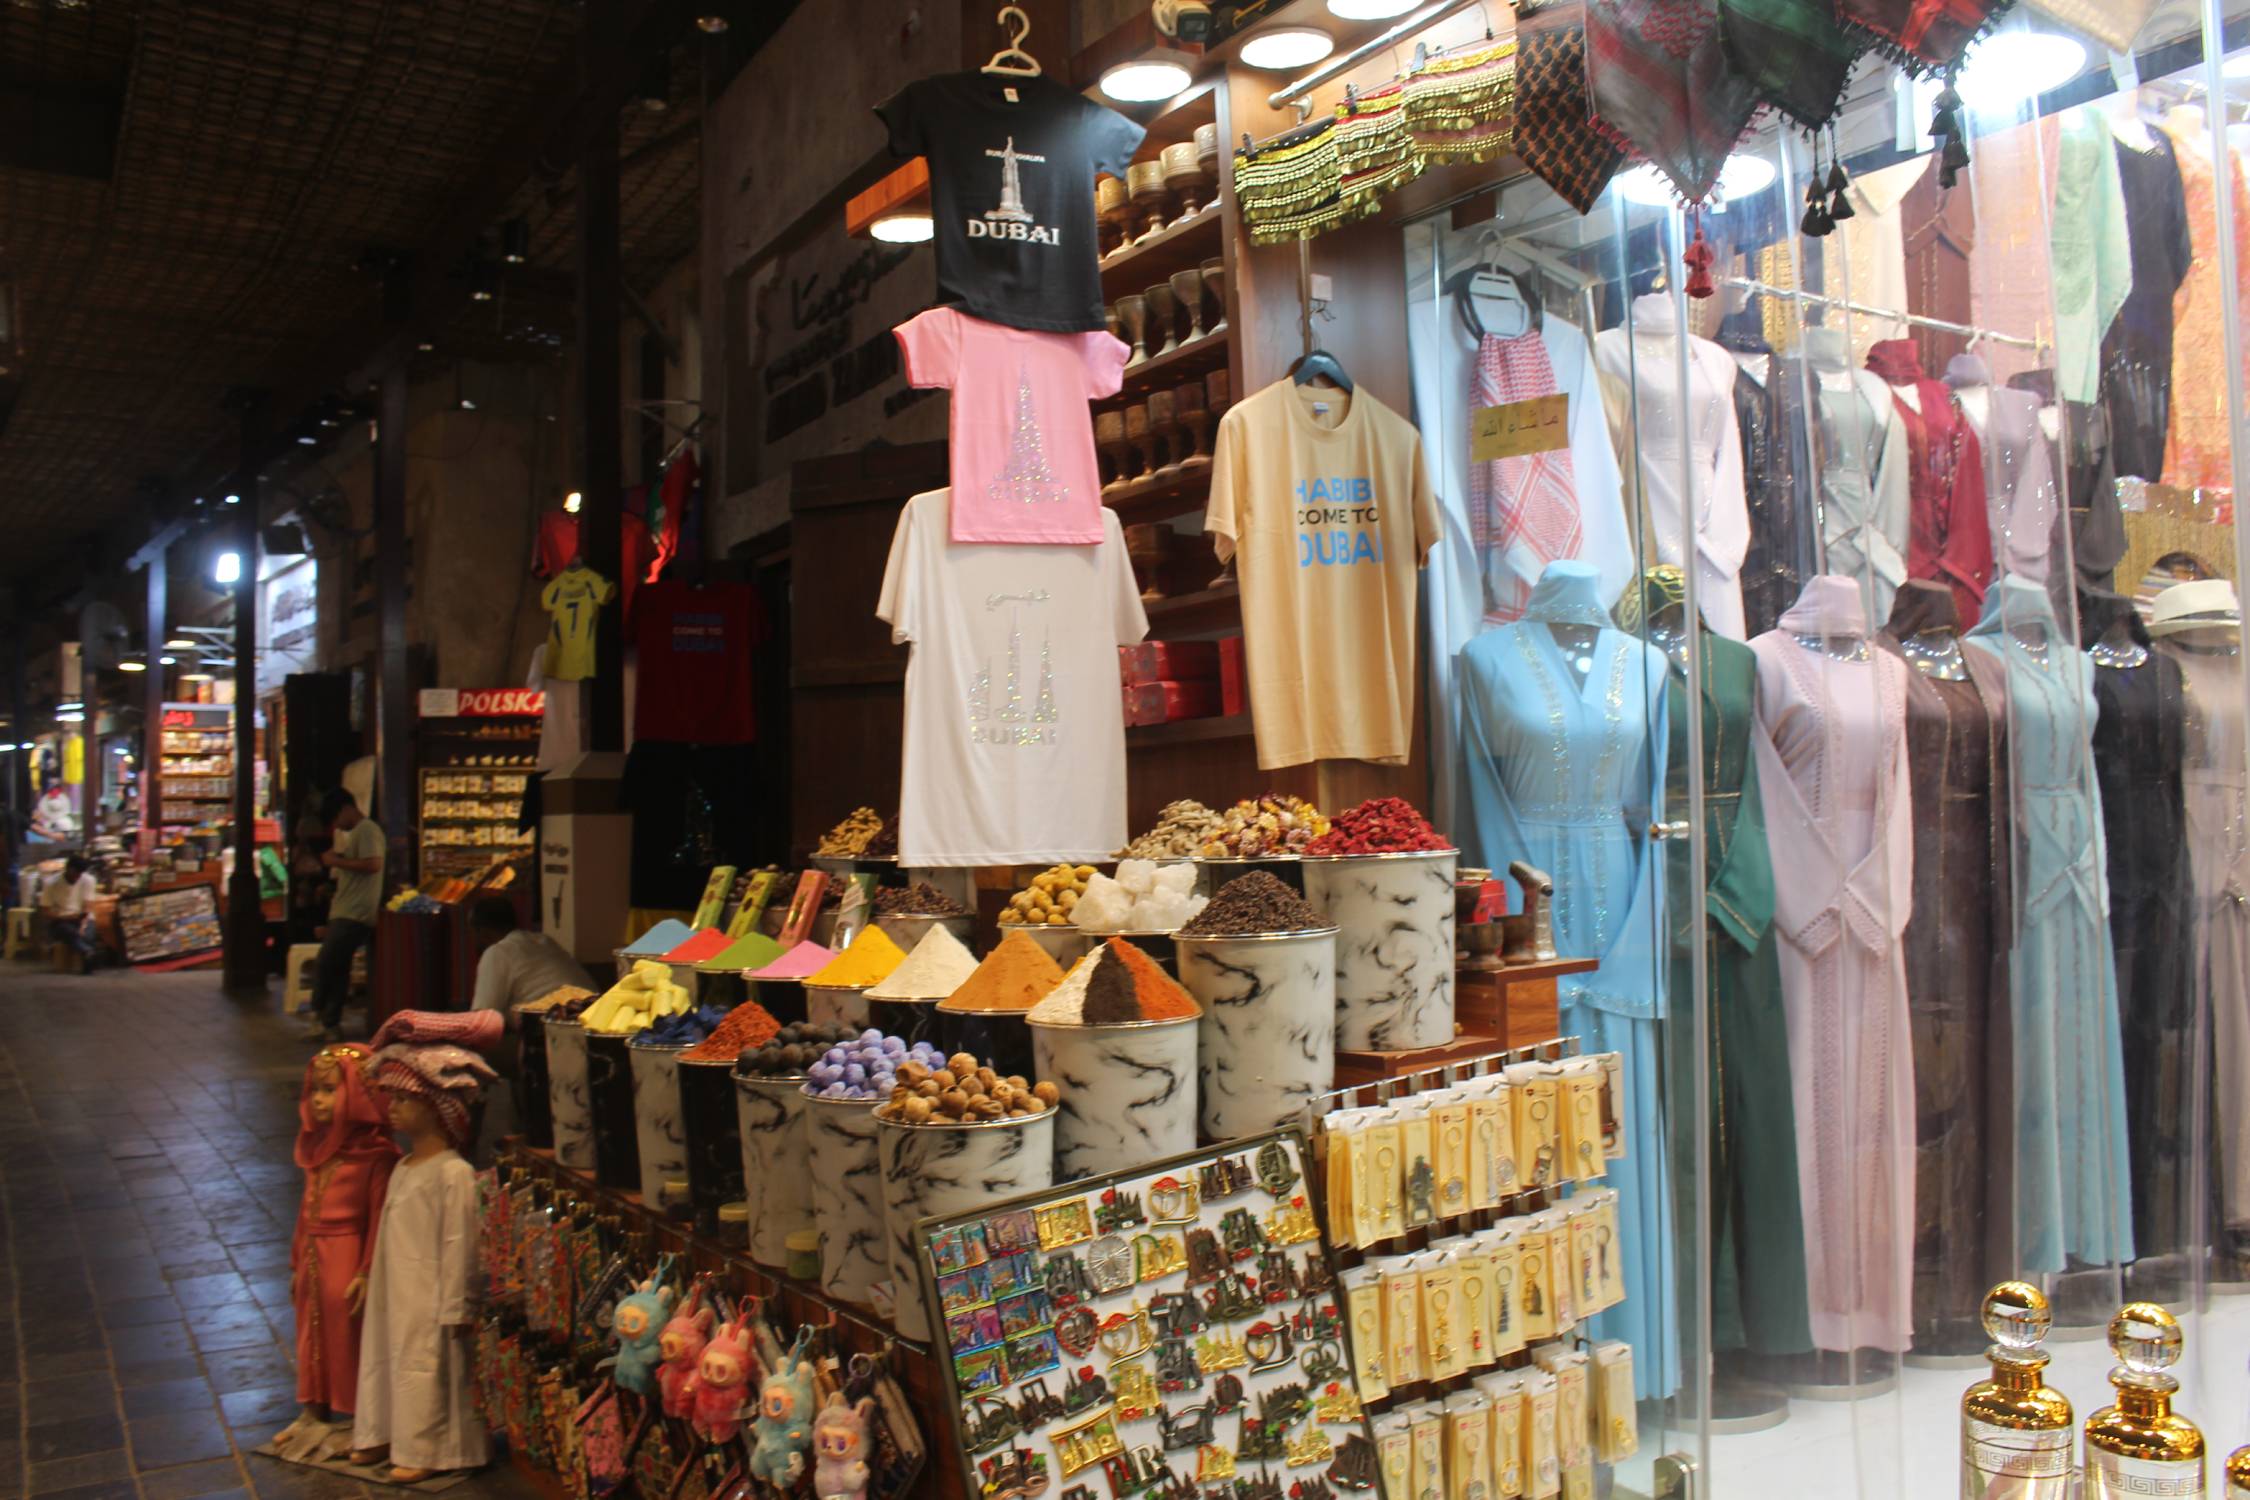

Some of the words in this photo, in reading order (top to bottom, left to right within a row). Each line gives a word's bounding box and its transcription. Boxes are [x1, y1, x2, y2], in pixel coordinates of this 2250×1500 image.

[967, 218, 1061, 246] DUBAI
[1297, 508, 1347, 526] COME
[459, 690, 547, 714] POLSKA
